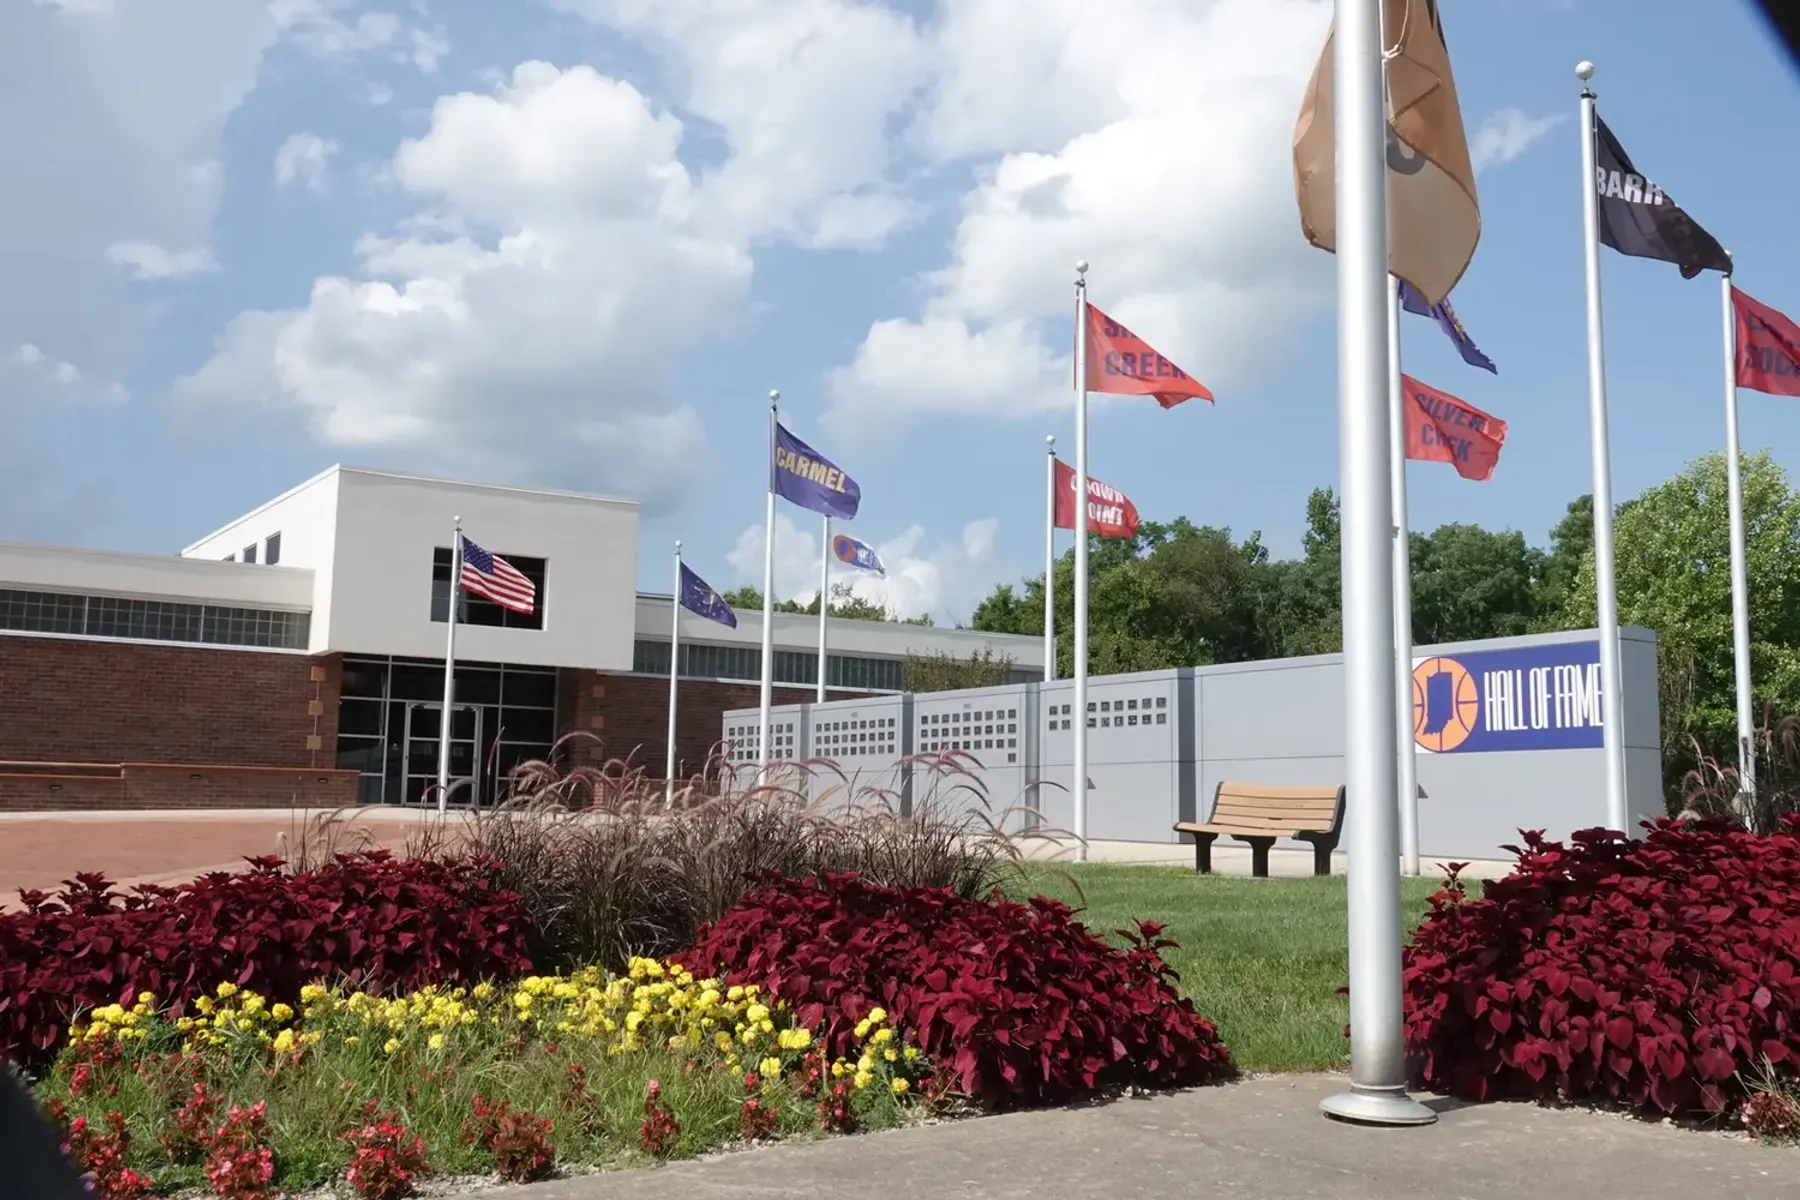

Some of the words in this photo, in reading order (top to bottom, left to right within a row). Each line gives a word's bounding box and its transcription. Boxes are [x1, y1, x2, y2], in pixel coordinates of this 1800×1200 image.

[776, 446, 846, 493] CARMEL
[1070, 474, 1124, 504] COWN
[1088, 501, 1123, 525] OINT
[1484, 669, 1528, 731] HALL
[1529, 667, 1551, 729] OF
[1554, 662, 1604, 728] FAME
